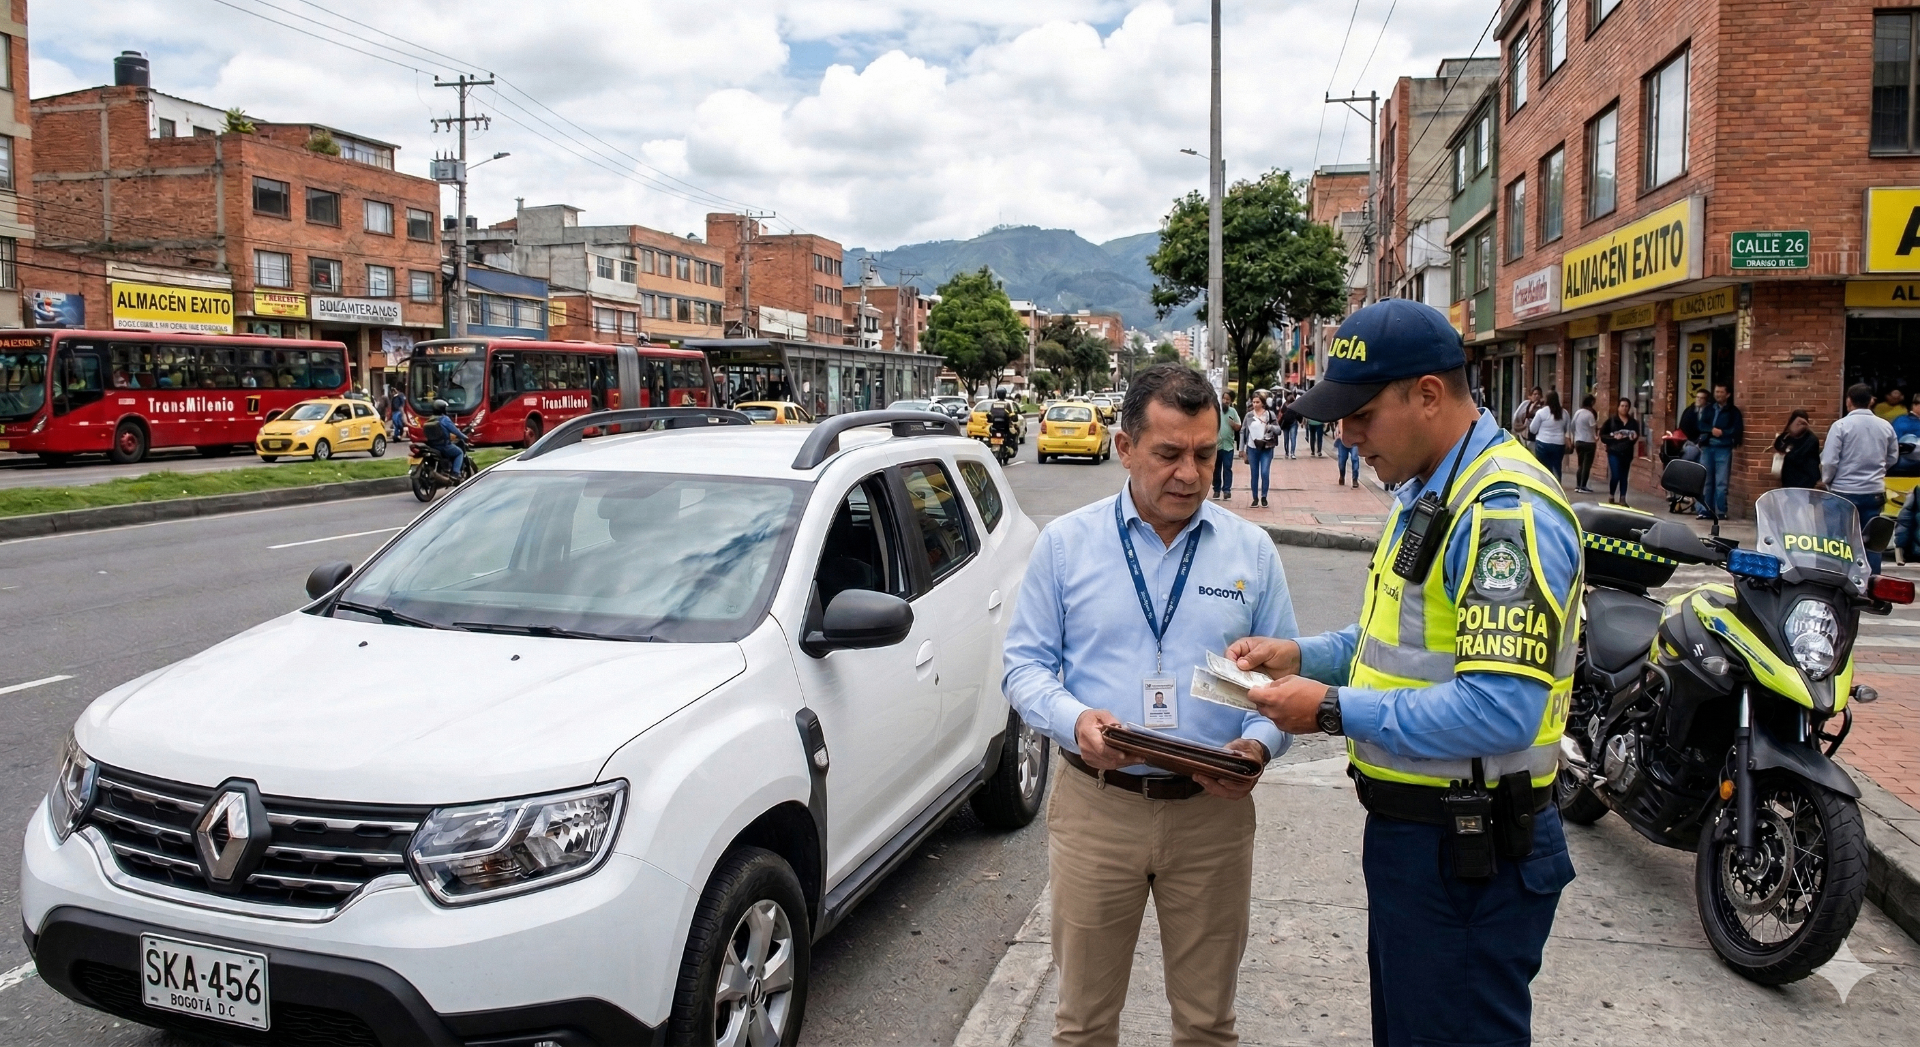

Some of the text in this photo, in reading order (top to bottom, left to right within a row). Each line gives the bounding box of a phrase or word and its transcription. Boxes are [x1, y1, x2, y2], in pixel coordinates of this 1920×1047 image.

[1736, 239, 1804, 253] CALLE 26
[1565, 236, 1628, 300] ALMACÉN
[1632, 219, 1684, 280] EXITO
[117, 290, 231, 315] ALMACÉN EXITO
[148, 397, 234, 413] TransMilenio
[542, 394, 588, 410] TransMilenio
[1784, 534, 1854, 563] POLICÍA
[1456, 604, 1549, 639] POLICÍA
[1455, 628, 1548, 665] TRÁNSITO
[170, 993, 212, 1013] BOGOTÁ
